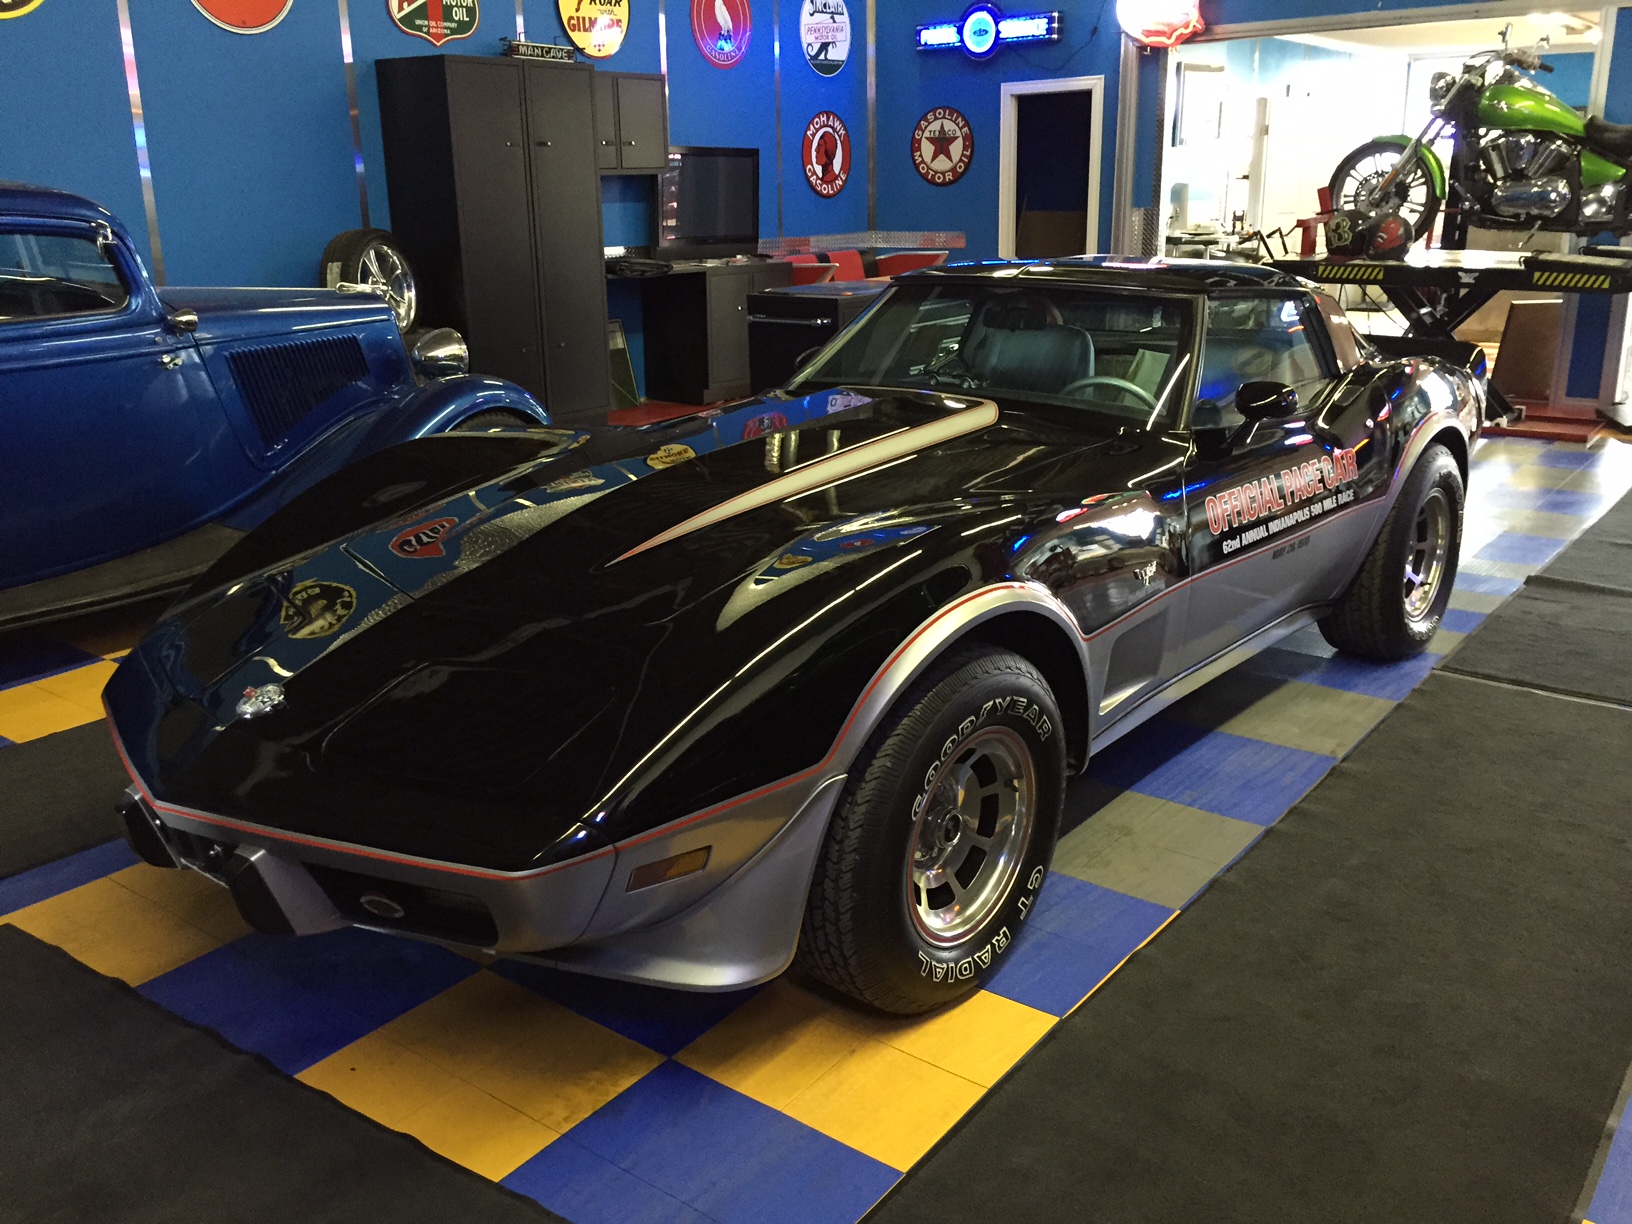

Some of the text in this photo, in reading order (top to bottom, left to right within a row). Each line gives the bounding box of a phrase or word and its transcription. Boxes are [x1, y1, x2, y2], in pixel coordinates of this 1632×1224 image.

[452, 7, 470, 21] OIL
[597, 8, 617, 16] with
[808, 0, 845, 15] SINCLAIR
[807, 25, 844, 35] PENNSYLVANIA
[518, 45, 569, 60] MAN CAVE
[807, 114, 847, 140] MOHAWK
[914, 109, 969, 139] GASOLINE
[806, 164, 847, 194] GASOLINE
[913, 148, 971, 183] MOTOR OIL
[1205, 448, 1358, 535] OFFICIAL PACE CAR
[1222, 489, 1354, 554] 62nd ANNUAL INDIANAPOLIS 500 MILE RACE
[911, 696, 1052, 821] GOODYEAR
[918, 865, 1044, 983] GT RADIAL
